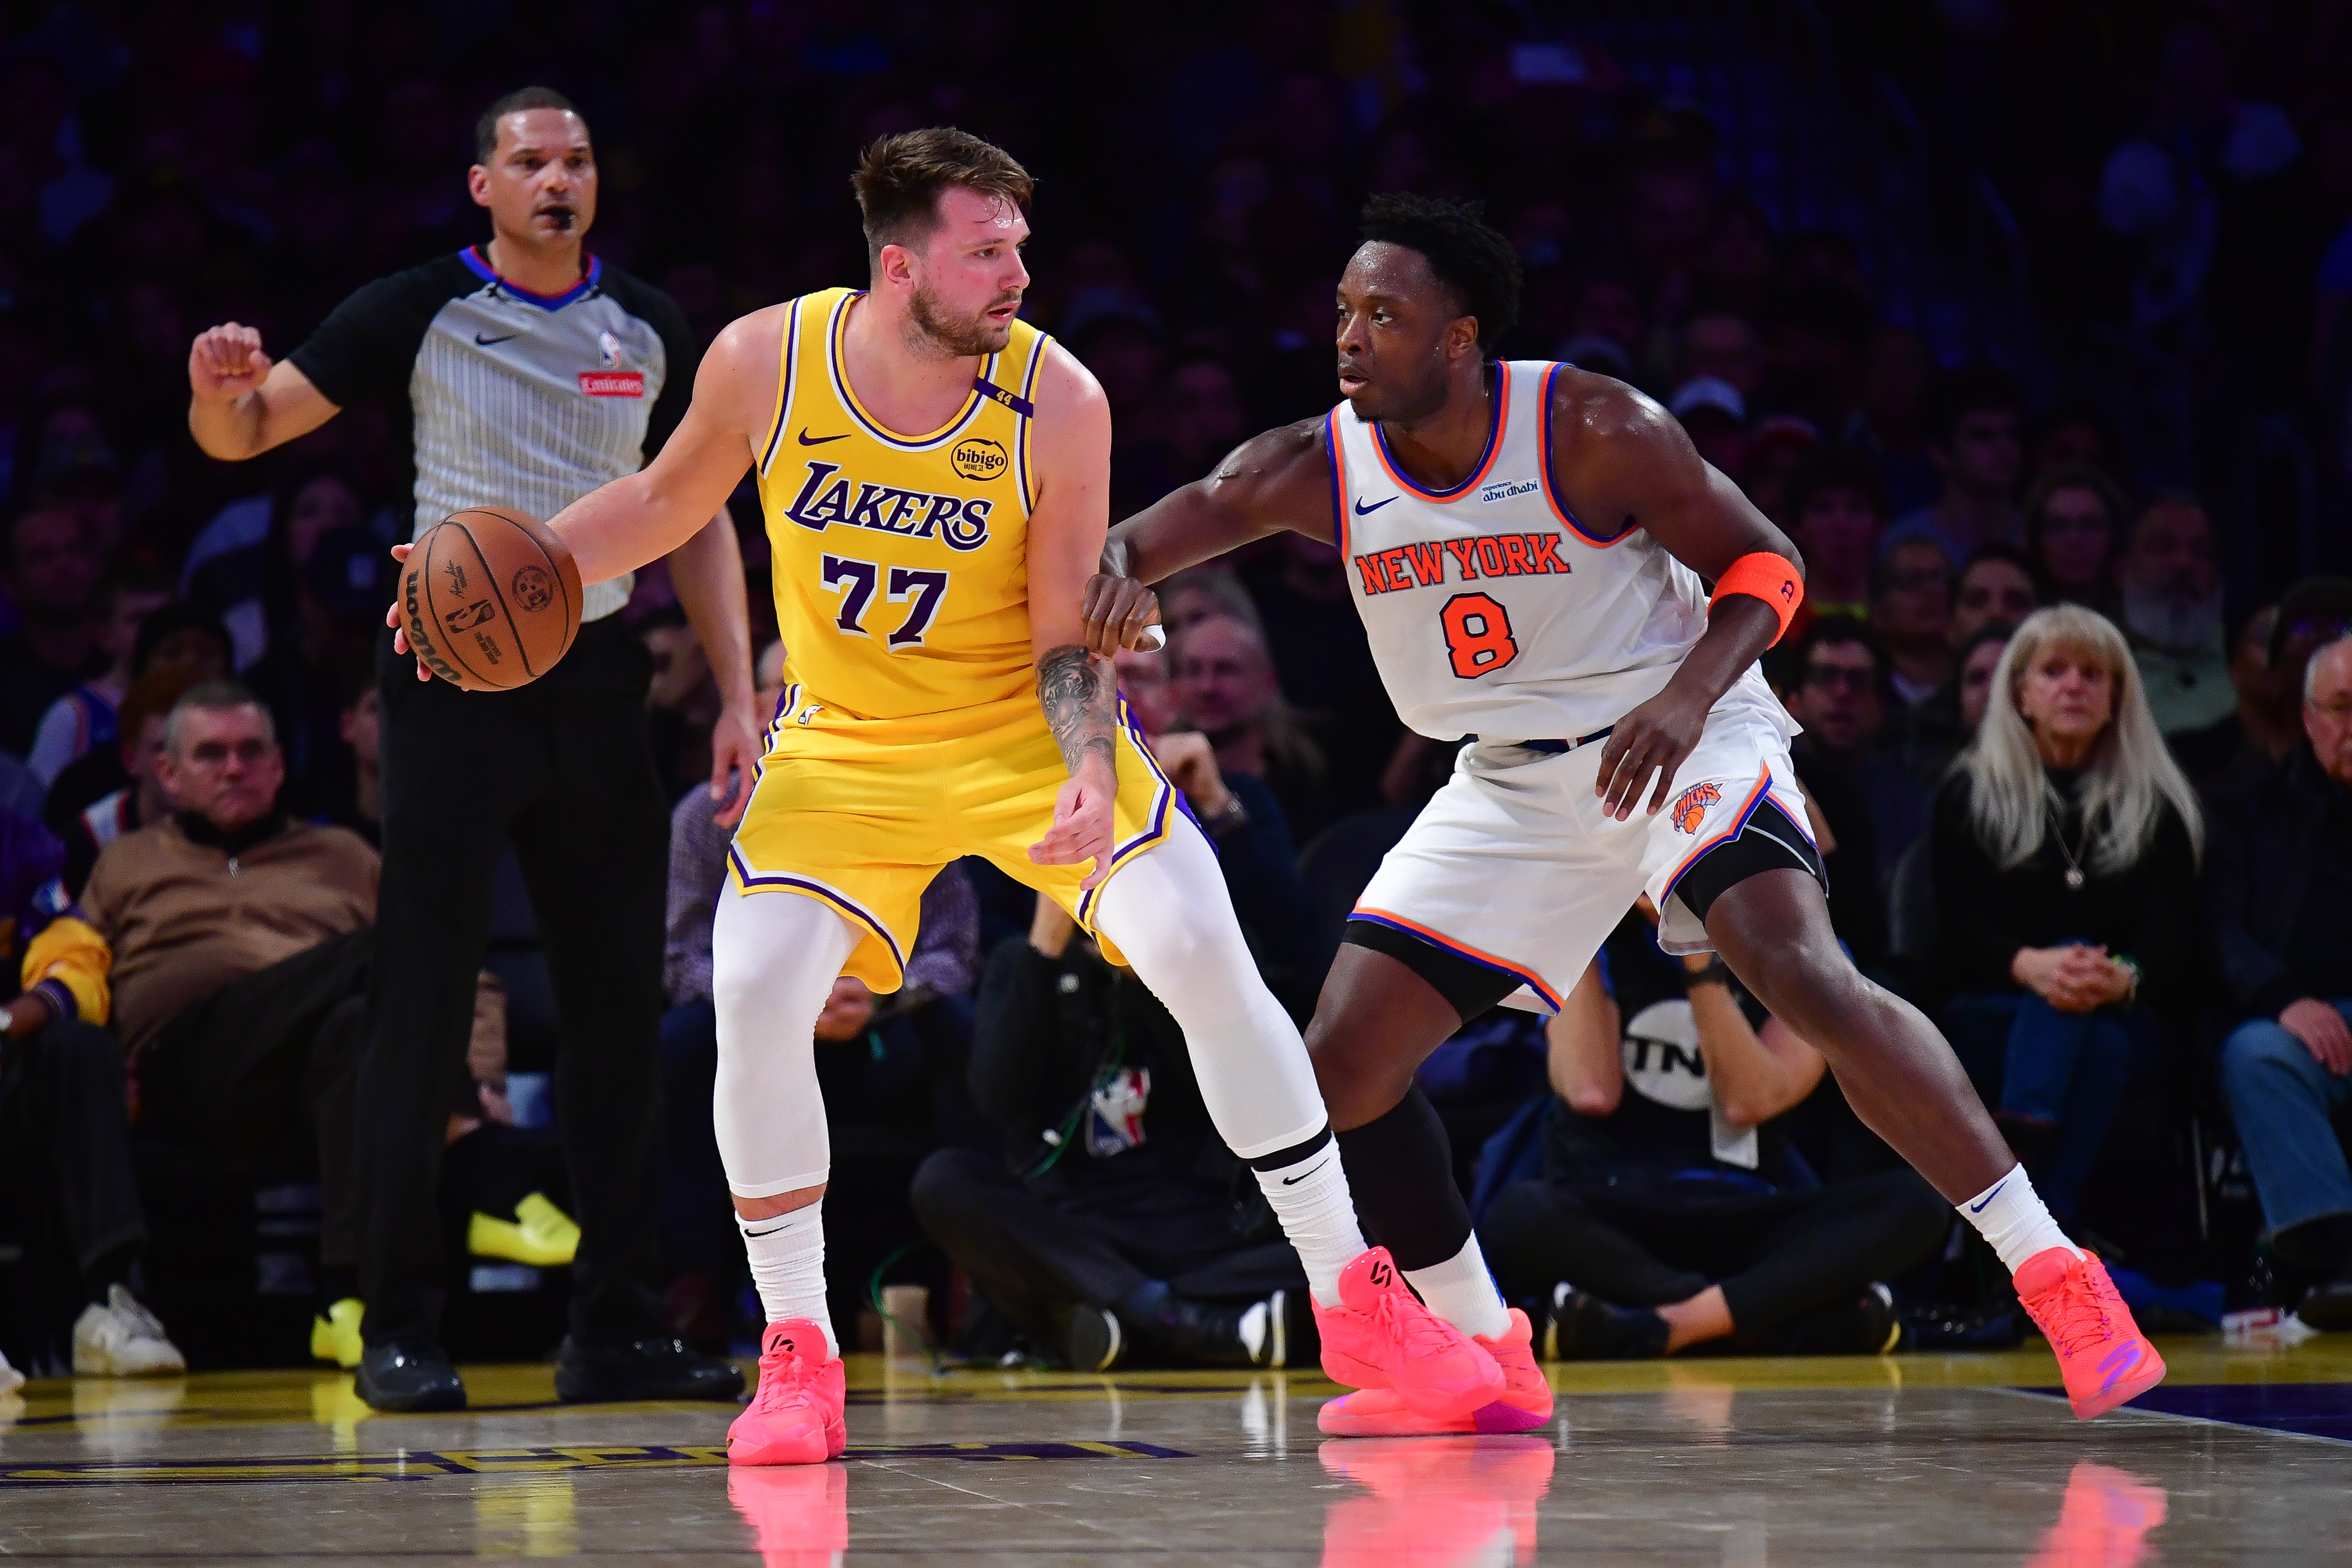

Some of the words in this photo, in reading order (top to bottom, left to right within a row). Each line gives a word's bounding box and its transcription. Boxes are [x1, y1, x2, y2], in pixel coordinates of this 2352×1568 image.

[997, 390, 1013, 406] 44
[957, 448, 1005, 470] bibigo
[964, 463, 984, 472] 비비고
[783, 459, 995, 552] LAKERS
[1483, 490, 1505, 502] abu
[1506, 481, 1538, 496] dhabi
[1353, 541, 1446, 596] NEW
[1446, 532, 1572, 581] YORK
[821, 552, 950, 654] 77
[1439, 591, 1519, 680] 8
[1622, 1036, 1705, 1076] TN
